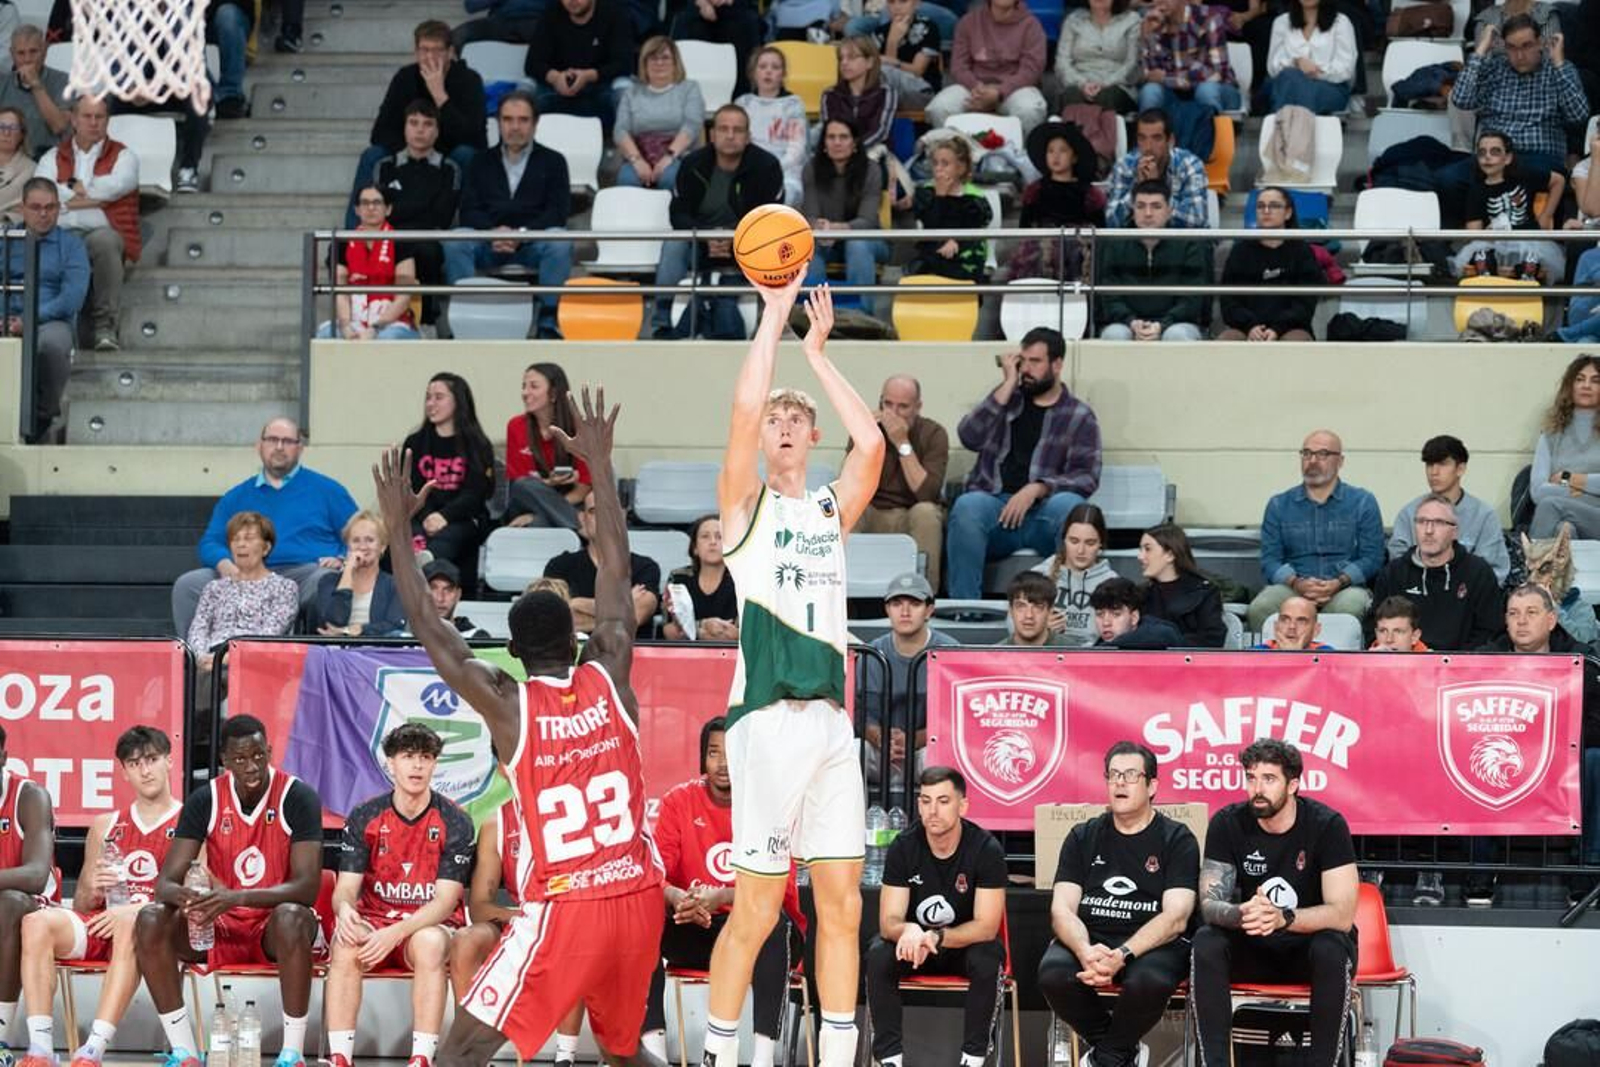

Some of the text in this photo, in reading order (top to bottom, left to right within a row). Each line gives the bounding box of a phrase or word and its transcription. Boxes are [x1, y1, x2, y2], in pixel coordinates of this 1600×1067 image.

[806, 602, 815, 632] 1
[535, 695, 611, 740] TRAORÉ
[969, 691, 1050, 720] SAFFER
[1456, 696, 1539, 724] SAFFER
[980, 718, 1038, 728] SEGURIDAD
[1143, 696, 1361, 769] SAFFER
[1467, 723, 1526, 733] SEGURIDAD
[535, 755, 556, 768] AIR
[1172, 768, 1328, 792] SEGUAD
[537, 769, 635, 863] 23
[373, 880, 436, 900] AMBAR
[1081, 894, 1159, 912] asademont
[1091, 907, 1132, 919] ZARAGOZA
